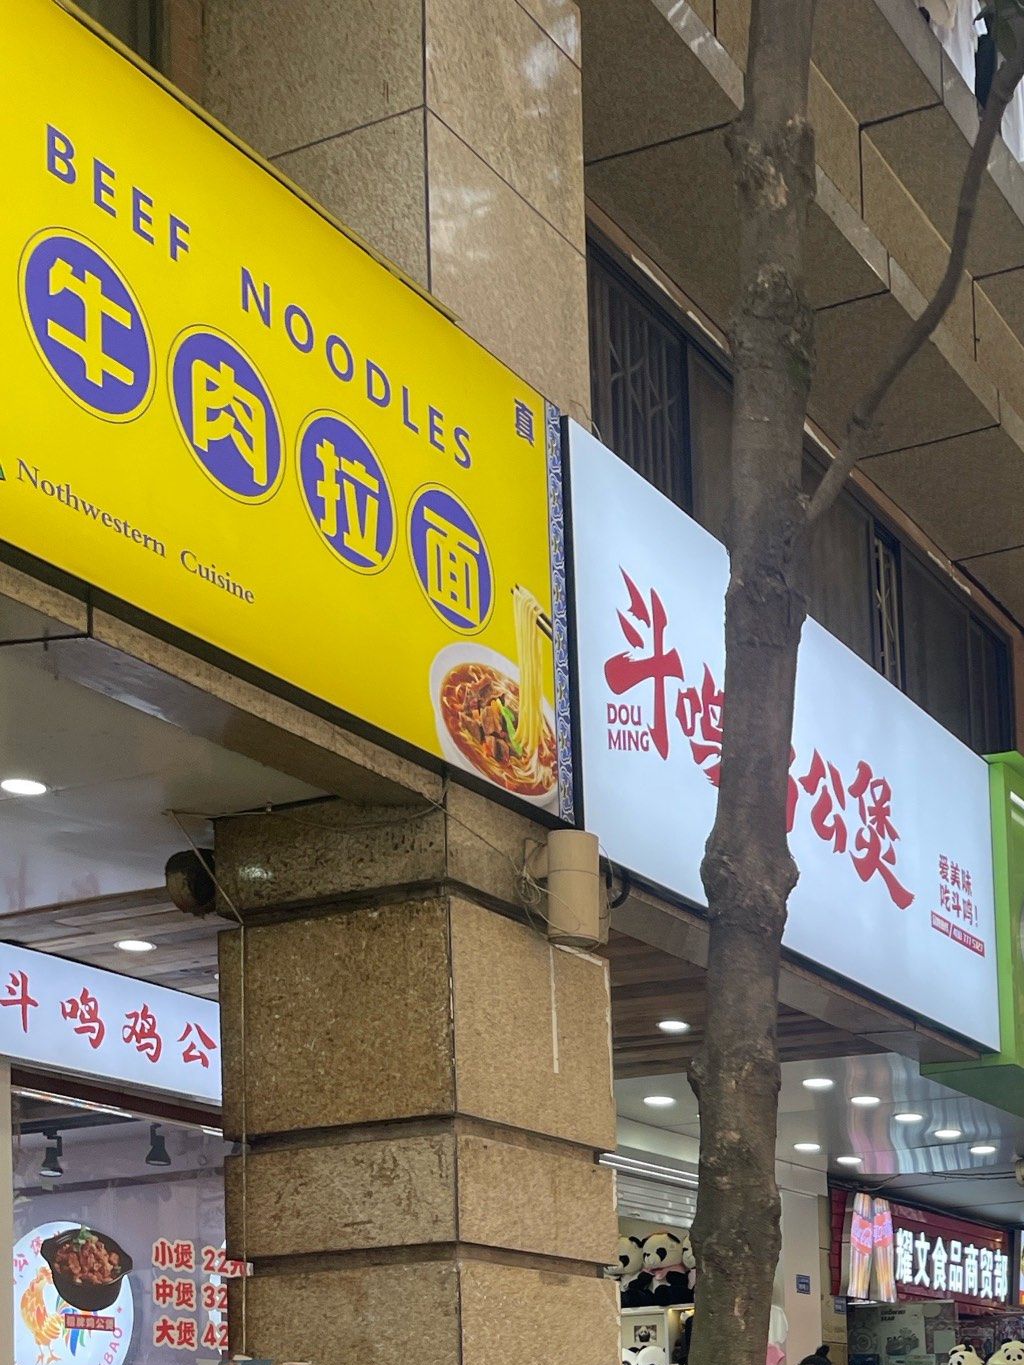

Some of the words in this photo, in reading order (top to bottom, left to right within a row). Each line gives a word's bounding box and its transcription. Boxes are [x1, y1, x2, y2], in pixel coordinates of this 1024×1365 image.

[46, 123, 192, 262] BEEF
[239, 266, 473, 471] NOODLES
[47, 256, 484, 630] 牛肉拉面
[16, 457, 167, 559] Nothwestern
[179, 550, 256, 605] Cuisine
[603, 564, 916, 911] 斗鸣公煲
[606, 702, 643, 728] DOU
[607, 728, 651, 753] MING
[0, 970, 218, 1070] 斗鸣鸡公
[154, 1240, 194, 1270] 小煲
[155, 1278, 195, 1309] 中煲
[894, 1227, 1010, 1304] 耀文食品商贸部
[155, 1318, 196, 1348] 大煲
